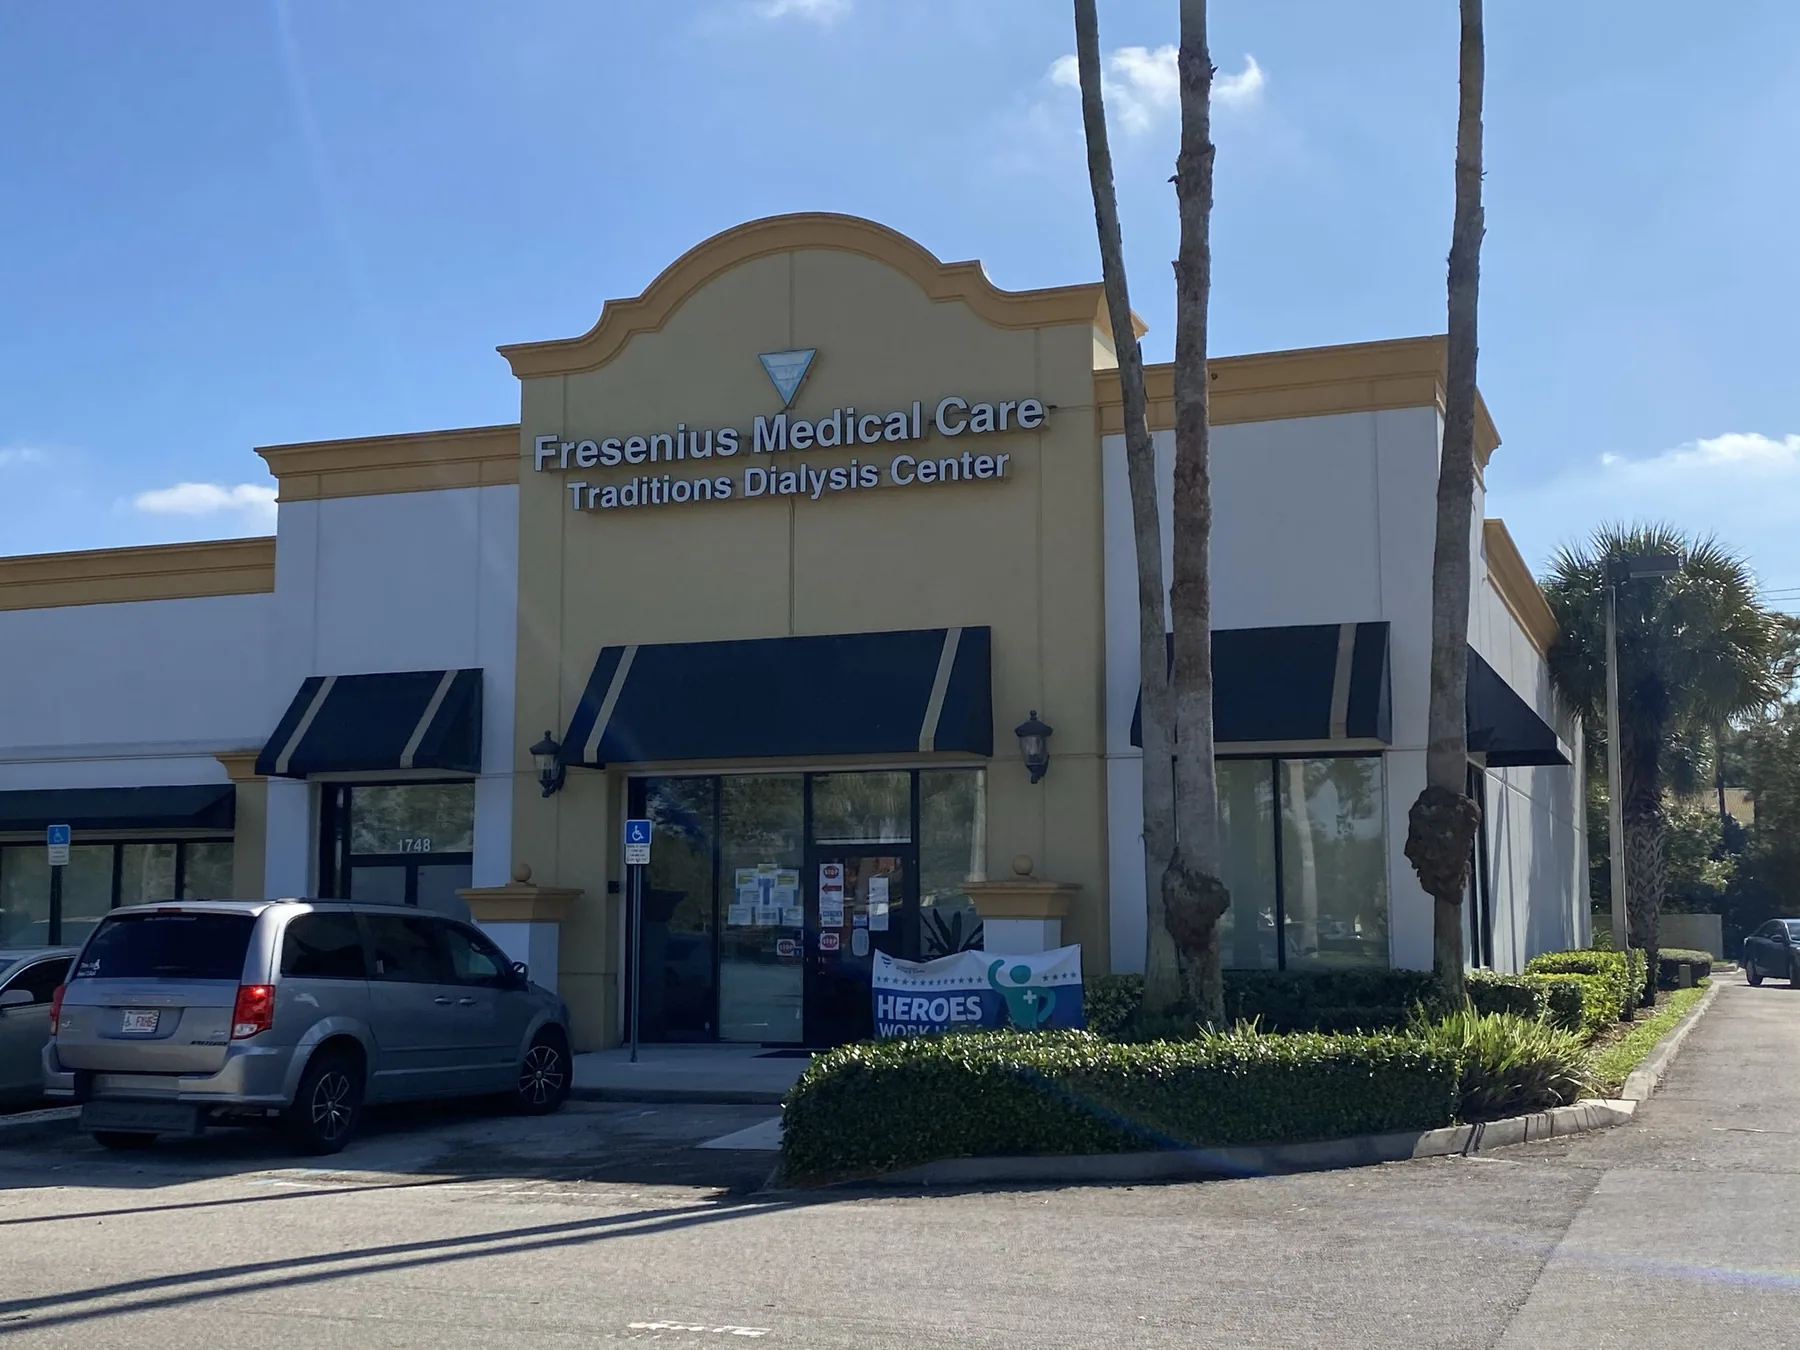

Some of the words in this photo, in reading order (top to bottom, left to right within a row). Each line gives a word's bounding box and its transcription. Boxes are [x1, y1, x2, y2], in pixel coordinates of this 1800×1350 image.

[534, 423, 740, 472] Fresenius
[752, 401, 922, 453] Medical
[935, 396, 1044, 437] Care
[567, 473, 732, 511] Traditions
[743, 458, 879, 499] Dialysis
[890, 451, 1011, 486] Center
[397, 838, 431, 853] 1748
[877, 994, 983, 1022] HEROES
